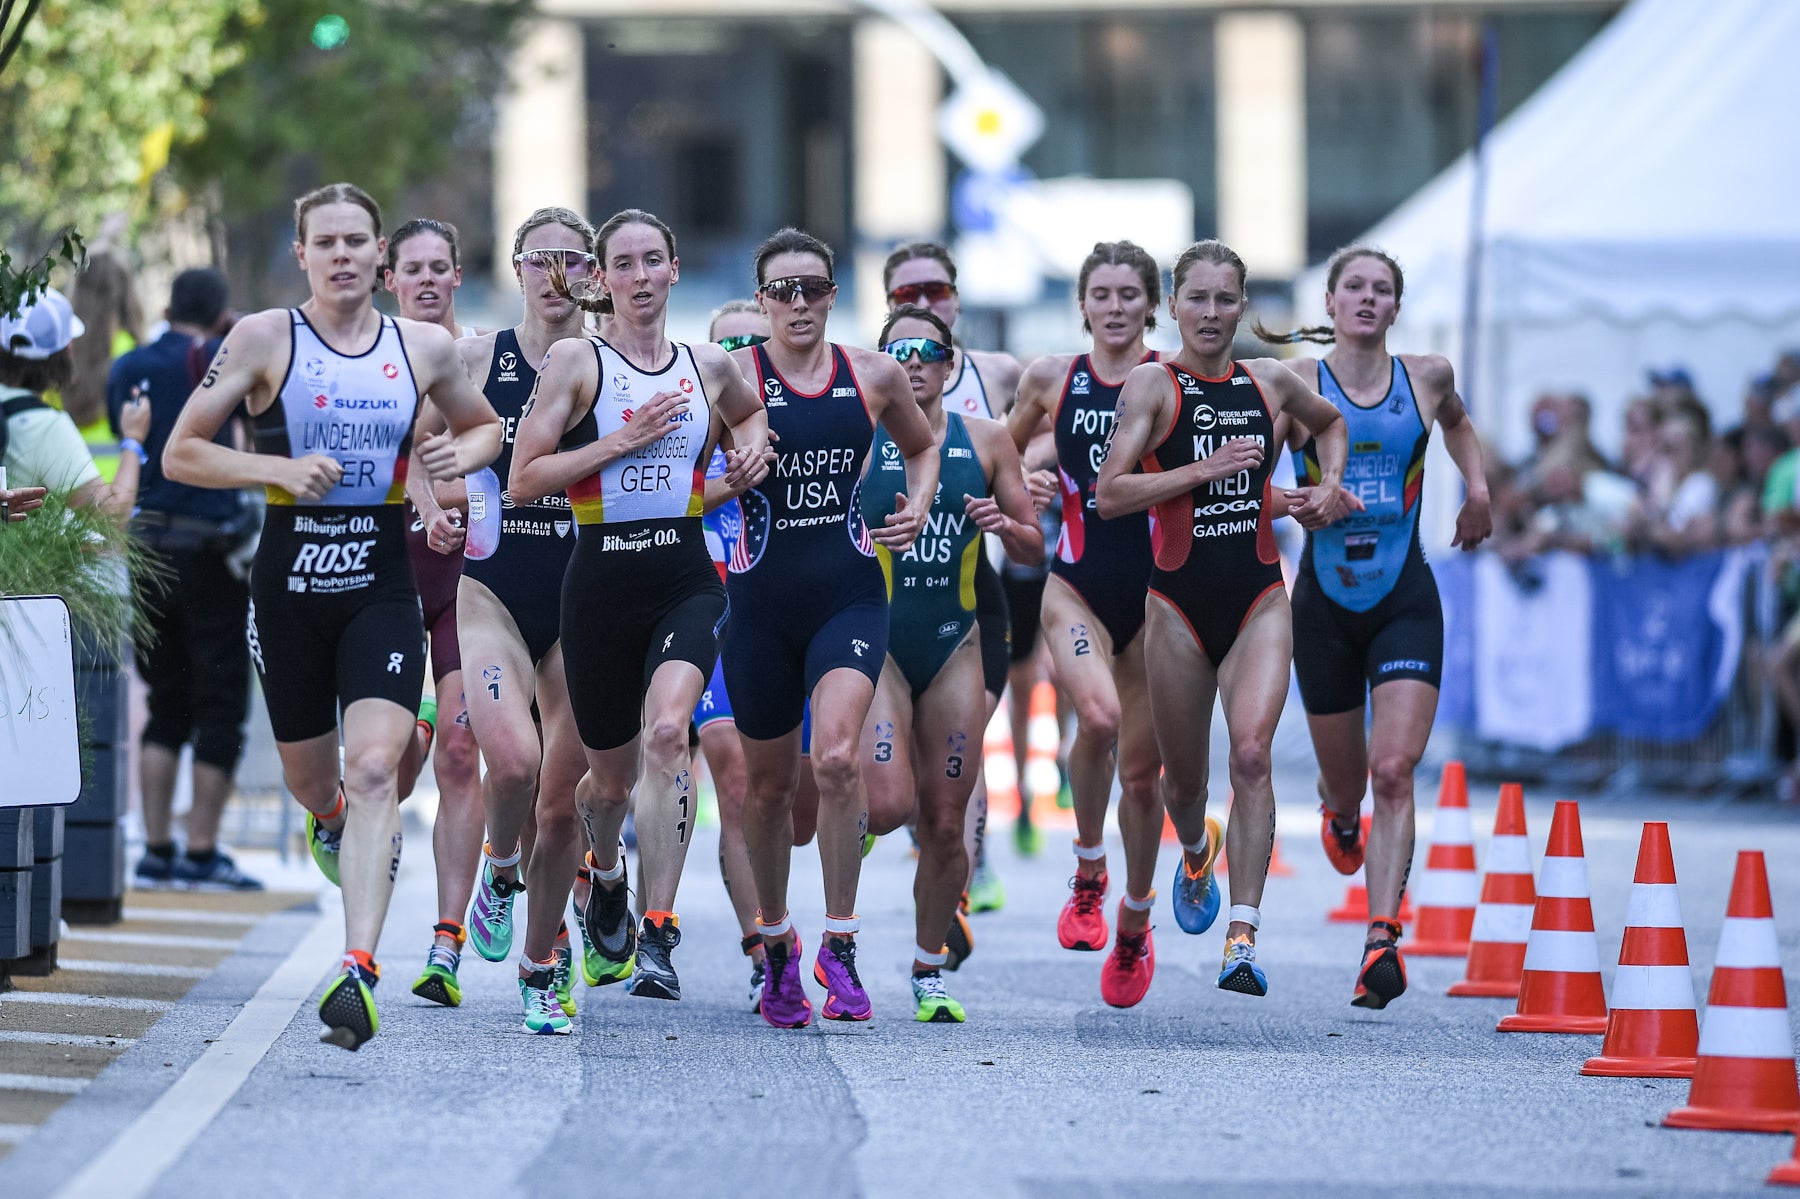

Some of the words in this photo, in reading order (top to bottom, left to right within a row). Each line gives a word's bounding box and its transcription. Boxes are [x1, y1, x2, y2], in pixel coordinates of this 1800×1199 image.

[202, 369, 219, 389] 5
[334, 398, 398, 409] SUZUKI
[304, 421, 396, 451] LINDEMANN
[340, 460, 376, 488] ER
[776, 448, 855, 478] KASPER
[620, 464, 672, 492] GER
[786, 481, 841, 510] USA
[1193, 500, 1260, 518] KOGA
[294, 515, 347, 537] Bitburger
[502, 520, 551, 530] BAHRAIN
[502, 527, 551, 536] VICTORIOUS
[601, 535, 652, 552] Bitburger
[902, 538, 951, 564] AUS
[292, 539, 377, 574] ROSE
[904, 577, 916, 587] 3T
[1074, 639, 1090, 656] 2
[487, 682, 500, 701] 1
[874, 741, 893, 763] 3
[945, 755, 963, 779] 3
